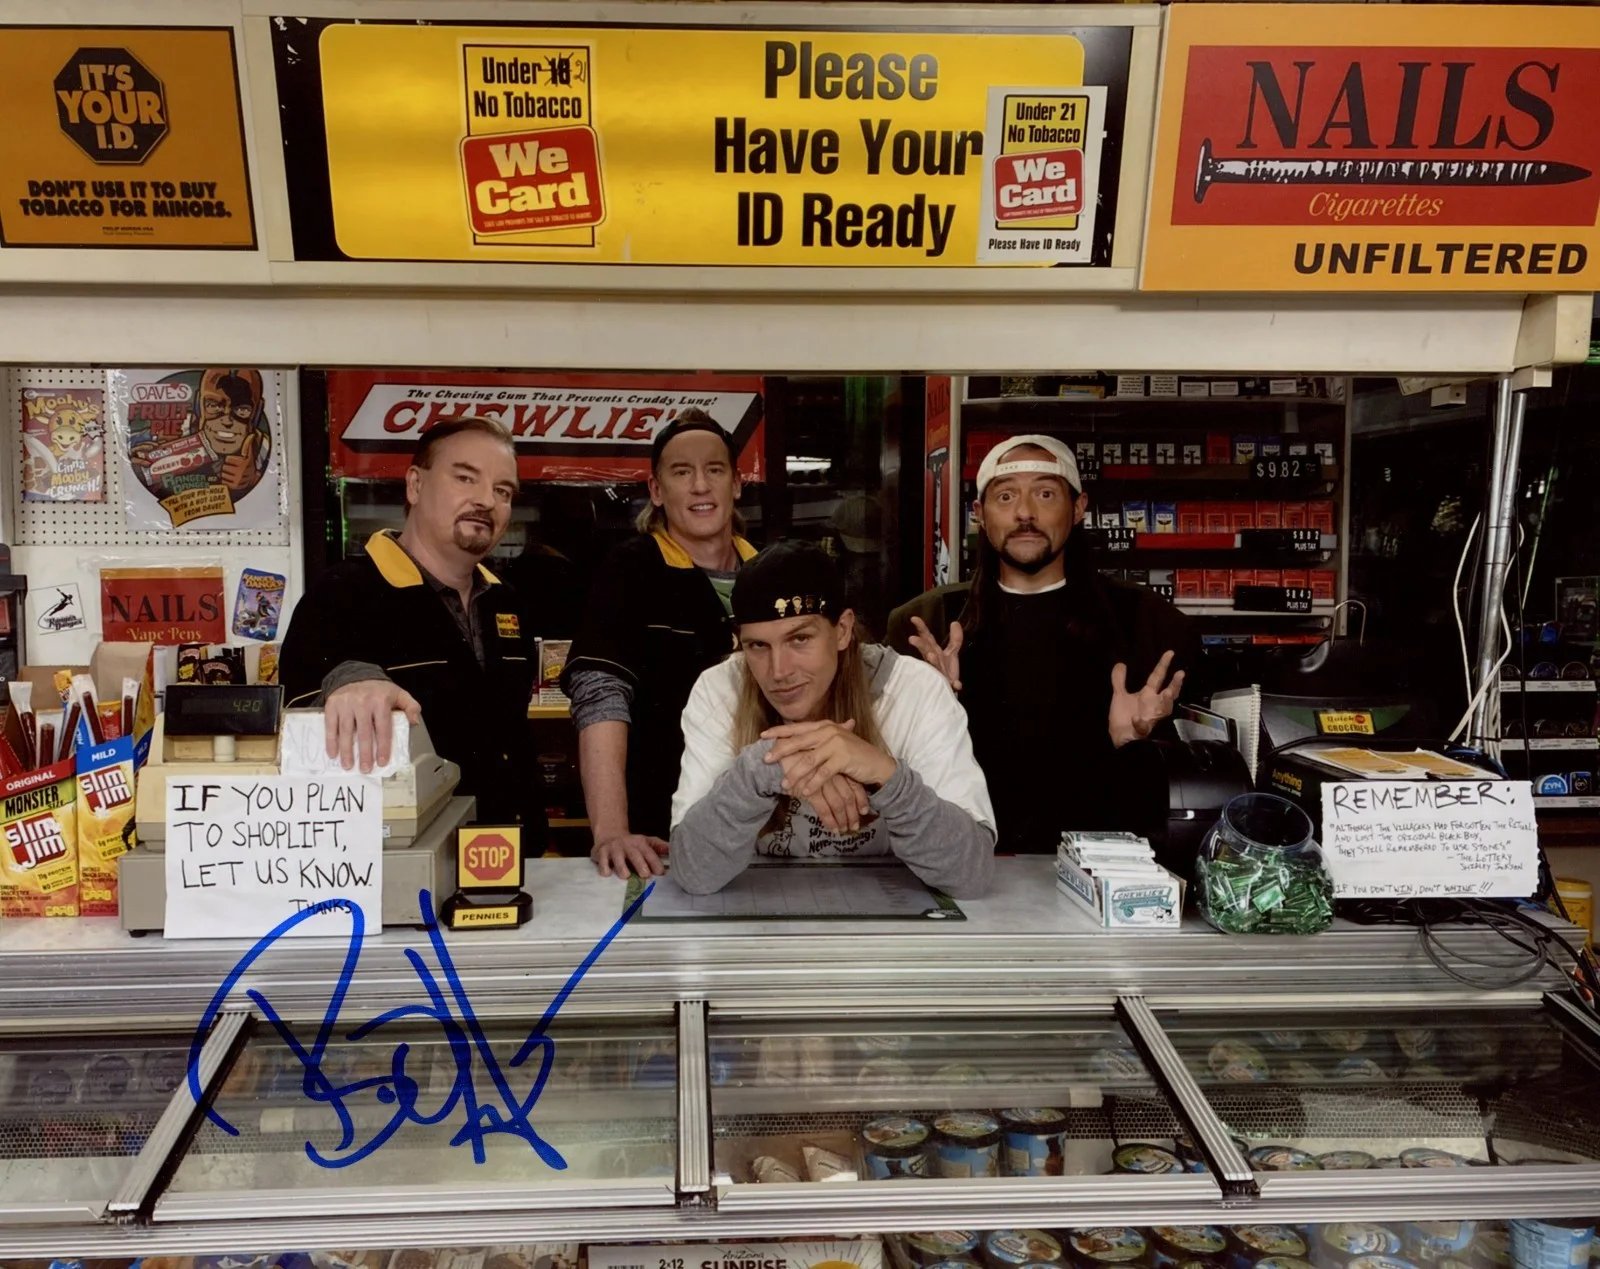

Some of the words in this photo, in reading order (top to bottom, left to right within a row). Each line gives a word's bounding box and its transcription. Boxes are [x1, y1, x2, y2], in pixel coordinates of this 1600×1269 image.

[79, 64, 134, 92] IT'S
[481, 57, 542, 84] Under
[765, 40, 939, 100] Please
[57, 90, 165, 125] YOUR
[474, 91, 499, 117] No
[503, 91, 582, 118] Tobacco
[1016, 102, 1056, 121] Under
[1060, 103, 1076, 121] 21
[1236, 60, 1561, 151] NAILS
[96, 124, 138, 150] I.D.
[1008, 125, 1025, 143] No
[1028, 125, 1081, 143] Tobacco
[714, 117, 840, 174] Have
[860, 118, 985, 176] Your
[488, 140, 570, 178] We
[1012, 157, 1066, 183] We
[27, 180, 86, 198] DON'T
[92, 181, 126, 198] USE
[130, 181, 150, 198] IT
[152, 182, 176, 198] TO
[180, 182, 217, 199] BUY
[475, 172, 590, 215] Card
[999, 178, 1077, 208] Card
[20, 199, 104, 217] TOBACCO
[110, 200, 148, 217] FOR
[152, 201, 232, 218] MINORS.
[1308, 192, 1444, 222] Cigarettes
[737, 191, 783, 246] ID
[802, 193, 956, 258] Ready
[988, 238, 1017, 250] Please
[1020, 238, 1040, 250] Have
[1043, 238, 1052, 250] ID
[1055, 238, 1081, 252] Ready
[1294, 242, 1588, 275] UNFILTERED
[406, 389, 432, 398] The
[435, 390, 494, 401] Chewing
[497, 391, 527, 400] Gum
[531, 392, 563, 401] That
[566, 394, 623, 403] Prevents
[627, 395, 675, 405] Cruddy
[678, 397, 718, 406] Lung!
[127, 403, 191, 421] FRUIT
[149, 419, 184, 436] PIE
[152, 460, 180, 472] CHERRY
[109, 593, 219, 623] NAILS
[126, 628, 164, 642] Vape
[168, 627, 202, 641] Pens
[1327, 724, 1369, 733] GROCERIES
[91, 748, 116, 762] MILD
[6, 770, 57, 792] ORIGINAL
[1272, 768, 1302, 791] Anything
[1544, 782, 1561, 790] ZYN
[5, 785, 60, 819] MONSTER
[173, 785, 221, 812] IF
[231, 783, 294, 815] YOU
[307, 782, 365, 813] PLAN
[1333, 782, 1515, 818] REMEMBER:
[173, 821, 223, 852] TO
[232, 820, 347, 852] SHOPLIFT,
[1335, 834, 1351, 842] AND
[1355, 833, 1374, 841] LOST
[1439, 832, 1461, 841] BLACK
[1434, 821, 1448, 830] HAD
[1450, 820, 1491, 831] FORGOTTEN
[1492, 821, 1507, 829] THE
[468, 846, 510, 869] STOP
[1335, 844, 1356, 858] THEY
[1357, 845, 1383, 855] STILL
[1453, 843, 1469, 852] USE
[1456, 853, 1473, 861] THE
[1476, 853, 1512, 865] LOTTERY
[48, 866, 72, 877] PROTEIN
[181, 859, 244, 889] LET
[255, 857, 289, 885] US
[1335, 884, 1348, 894] IF
[1353, 885, 1367, 894] YOU
[1444, 884, 1477, 895] WHINE
[462, 912, 510, 921] PENNIES
